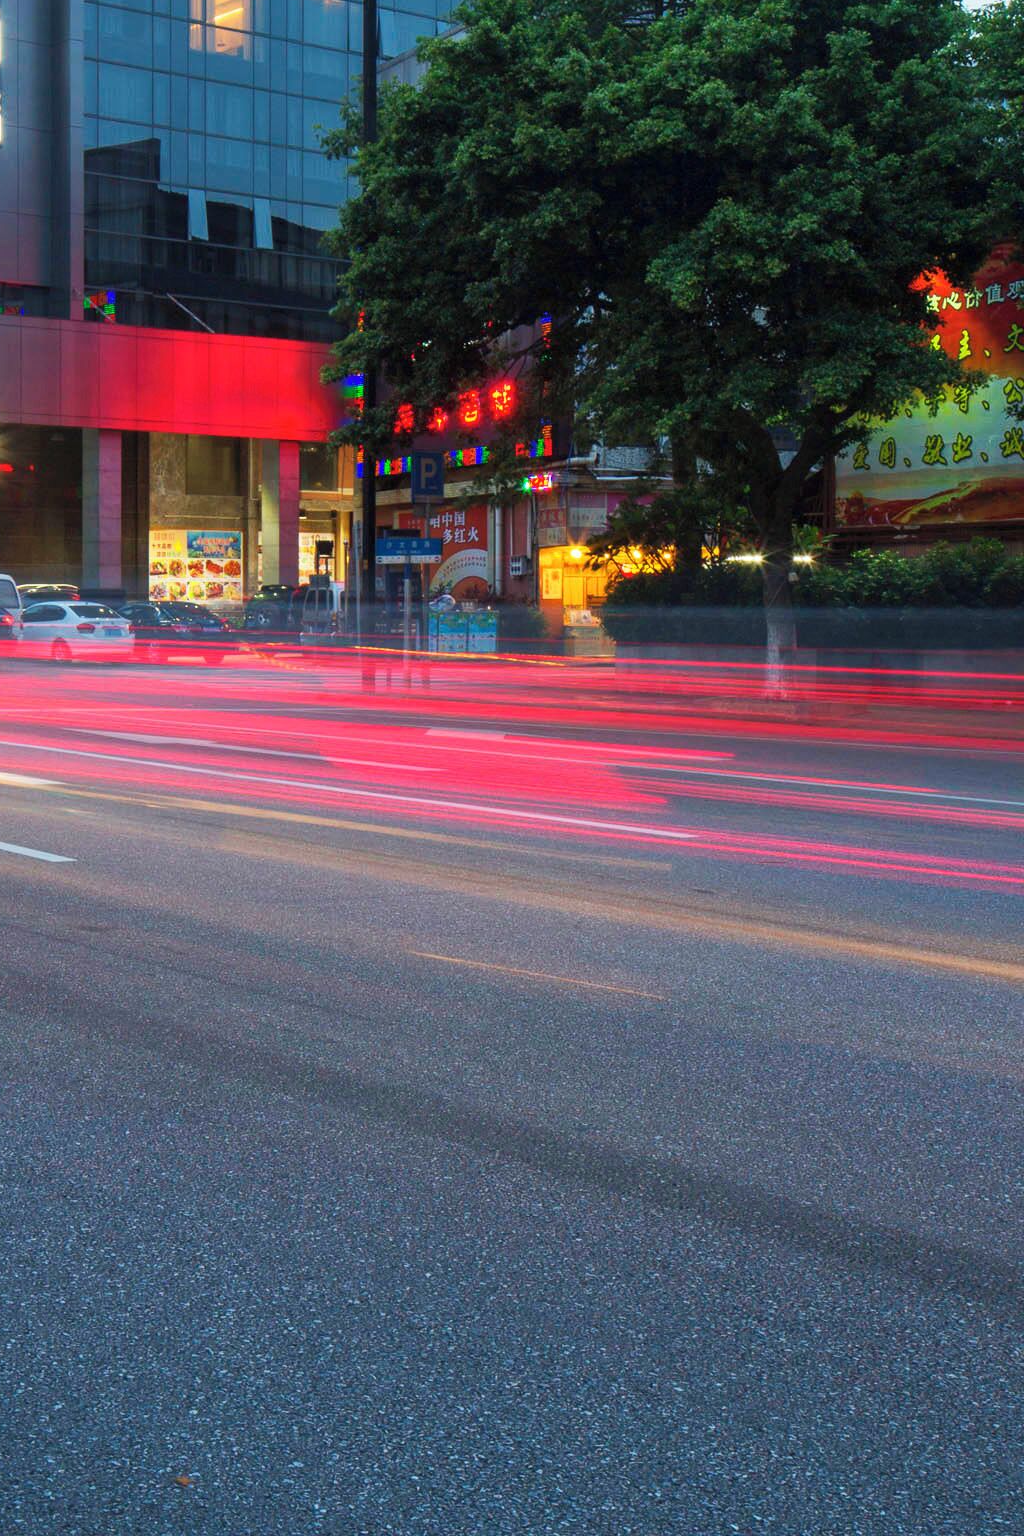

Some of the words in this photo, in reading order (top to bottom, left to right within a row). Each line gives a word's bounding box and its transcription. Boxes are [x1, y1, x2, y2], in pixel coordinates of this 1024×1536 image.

[420, 458, 437, 488] P
[442, 526, 479, 545] 多红火
